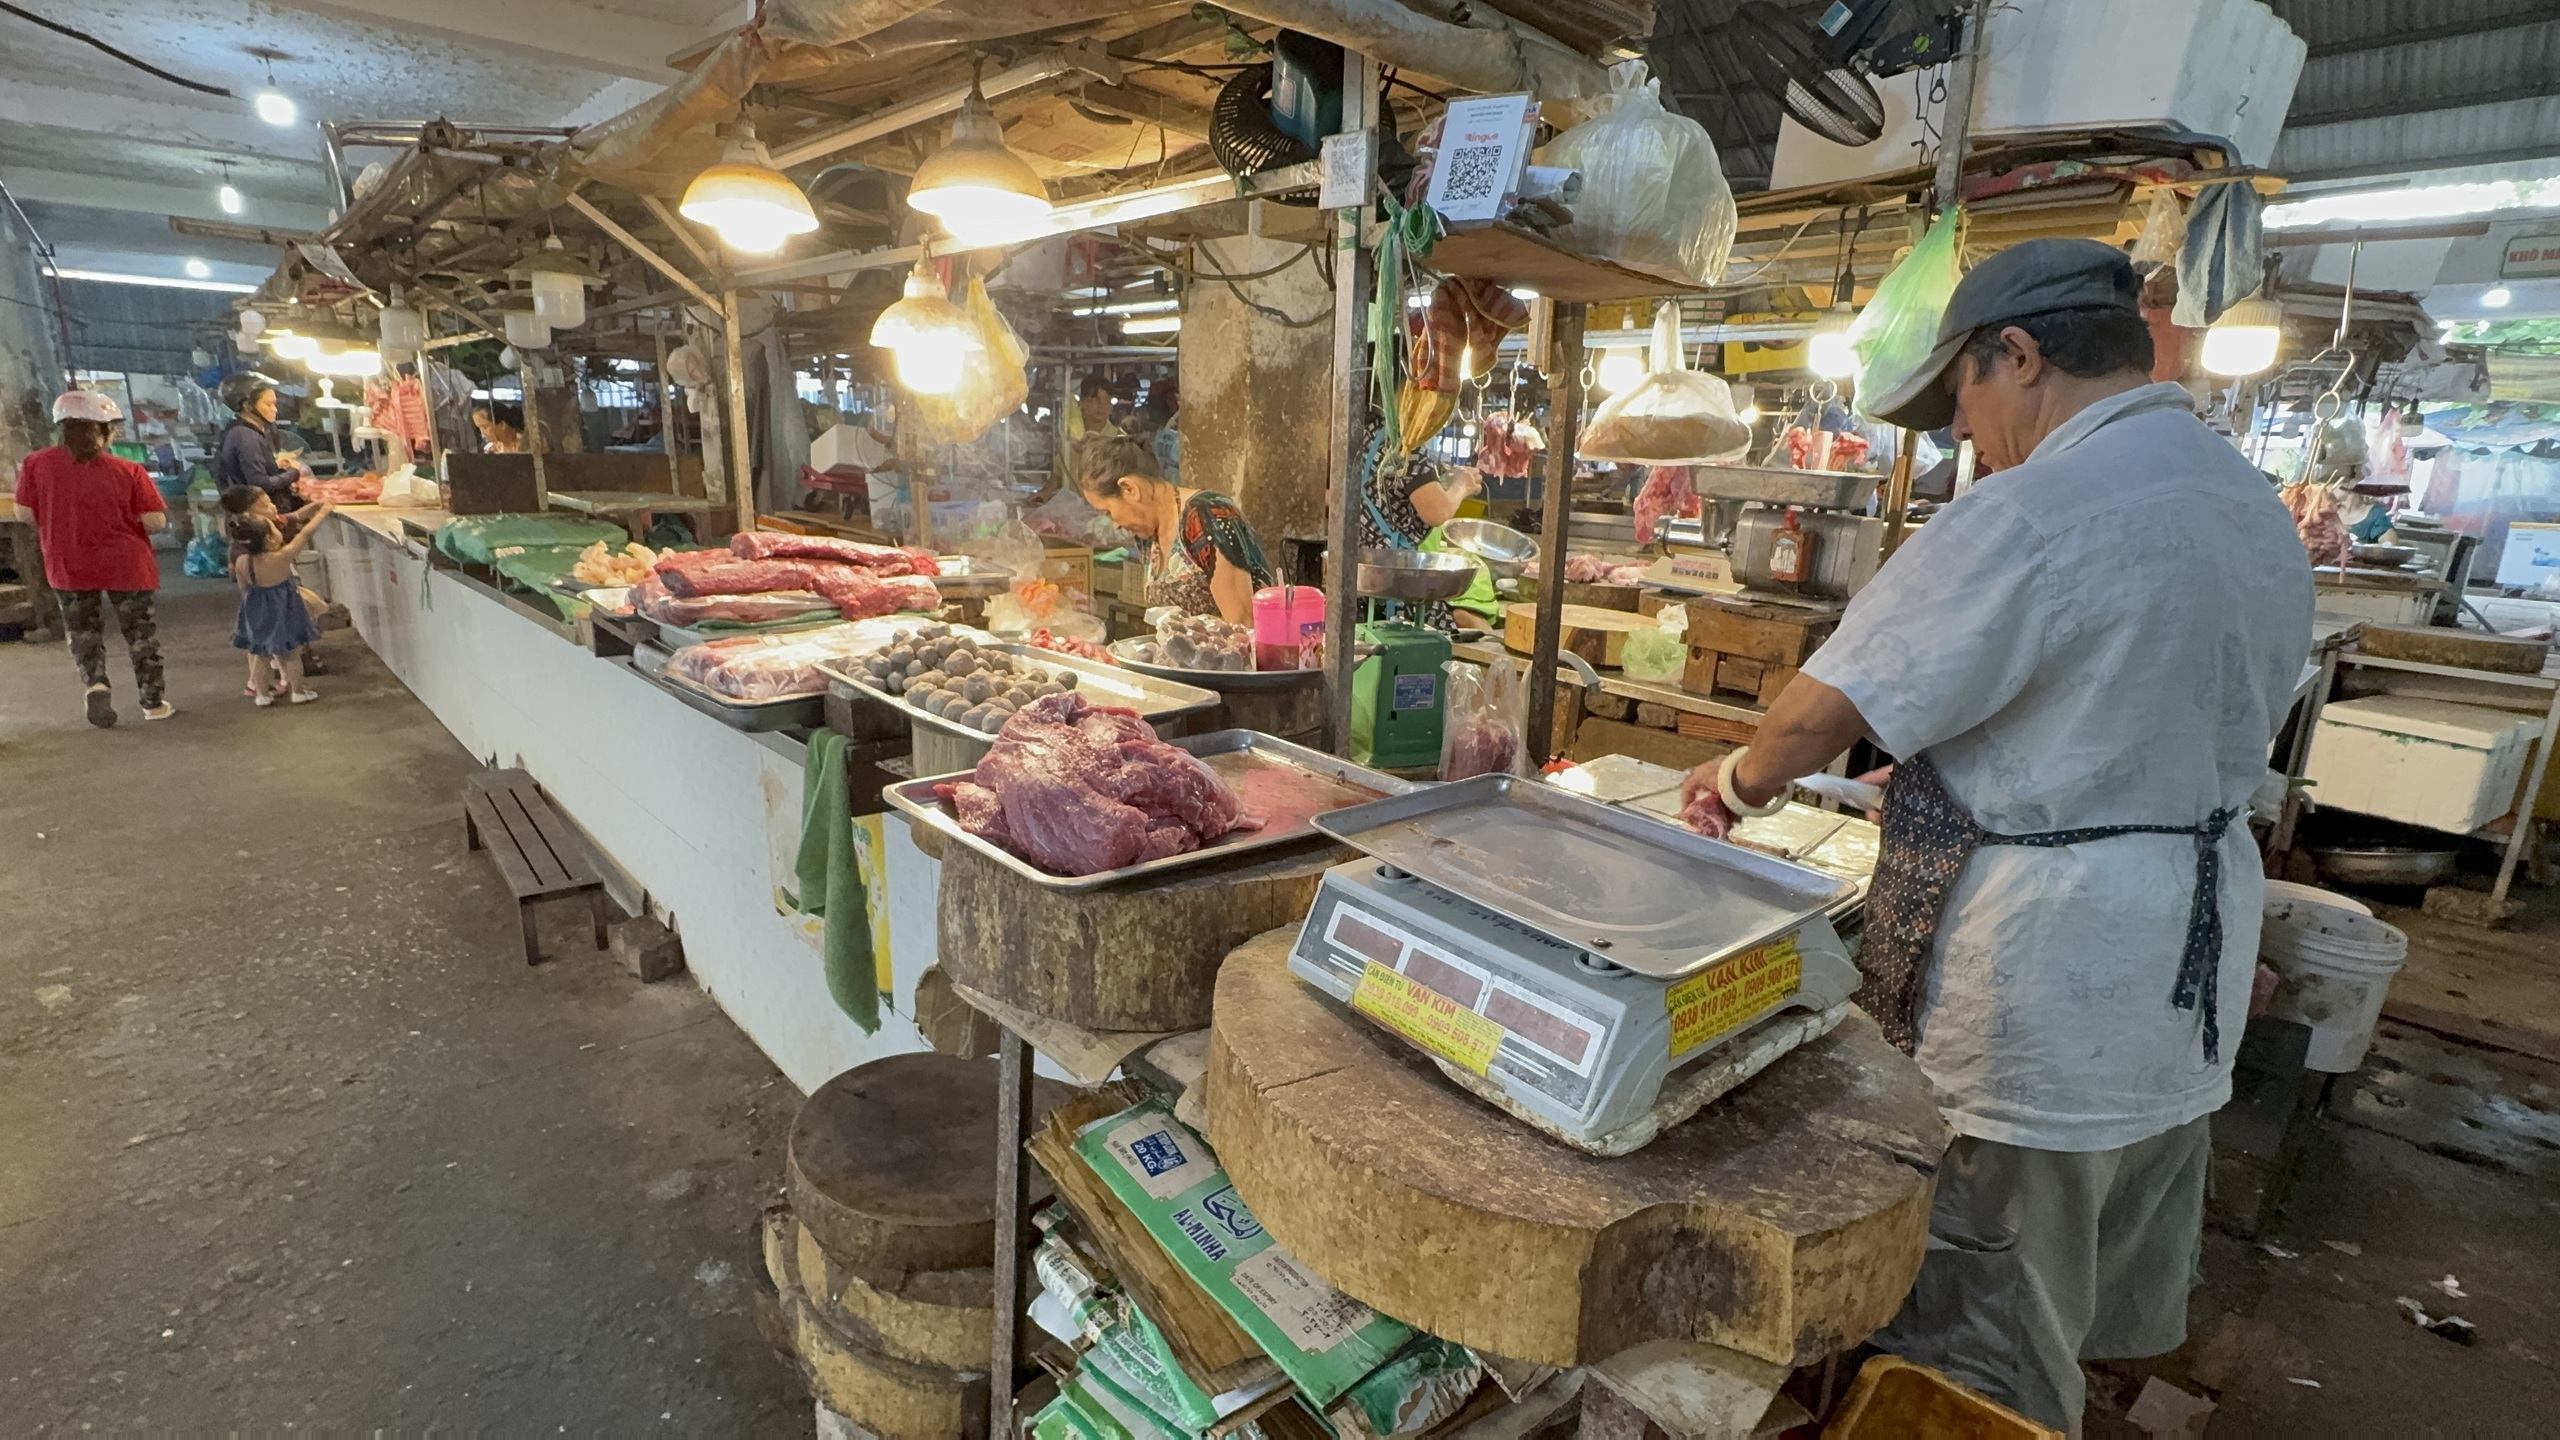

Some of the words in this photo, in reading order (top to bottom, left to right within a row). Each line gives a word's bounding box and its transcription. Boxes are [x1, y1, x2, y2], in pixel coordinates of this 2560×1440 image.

[1706, 963, 1738, 991] VẠN
[1739, 950, 1768, 976] KIM
[1406, 982, 1432, 1006] VẠN
[1431, 994, 1458, 1019] KIM
[1674, 1005, 1699, 1033] 0938
[1701, 996, 1718, 1021] 918
[1720, 987, 1738, 1011] 099
[1744, 974, 1766, 999] 0909
[1426, 1013, 1451, 1035] 0909
[1133, 1141, 1148, 1154] 20
[1139, 1153, 1160, 1172] KG.
